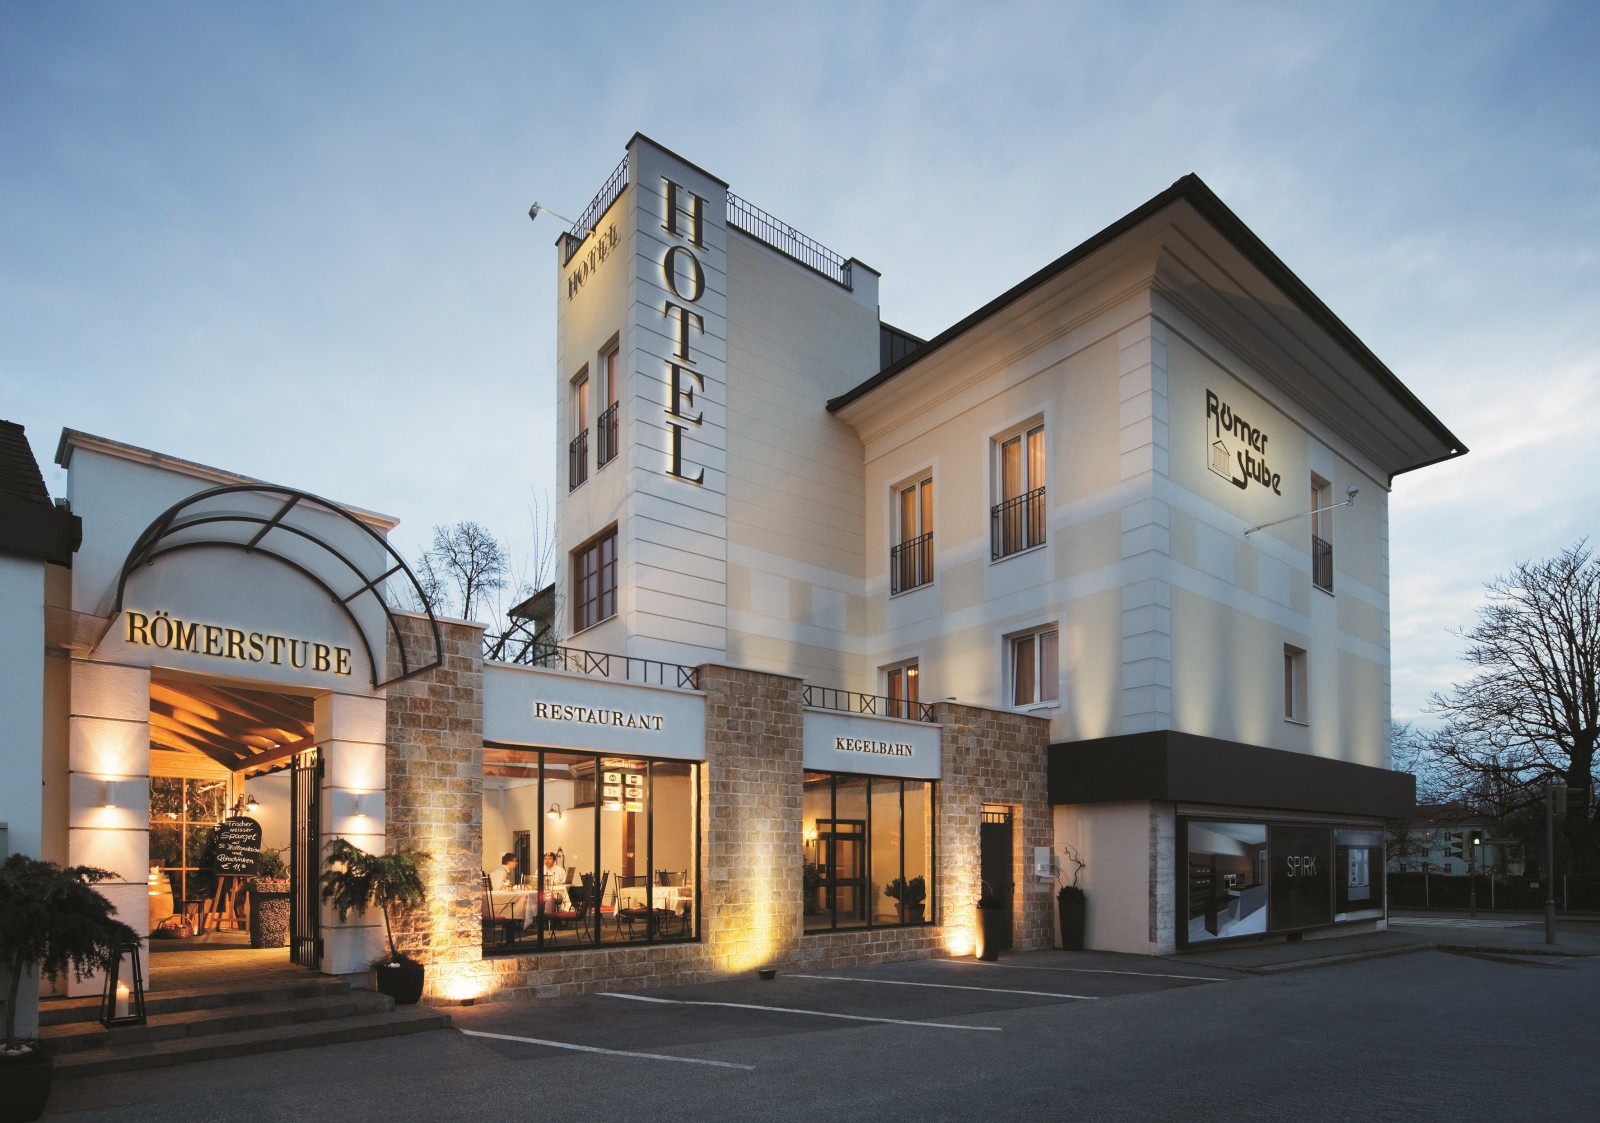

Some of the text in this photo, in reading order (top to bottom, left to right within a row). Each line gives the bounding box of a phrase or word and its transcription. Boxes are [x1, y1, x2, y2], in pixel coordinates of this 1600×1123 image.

[567, 223, 621, 302] HOTEL
[660, 175, 709, 485] HOTEL
[1206, 388, 1268, 455] Römer
[125, 610, 352, 676] RÖMERSTUBE
[534, 702, 664, 731] RESTAURANT
[836, 737, 912, 756] KEGELBAHN
[220, 832, 257, 842] Spargel
[1287, 856, 1317, 877] SPIRK
